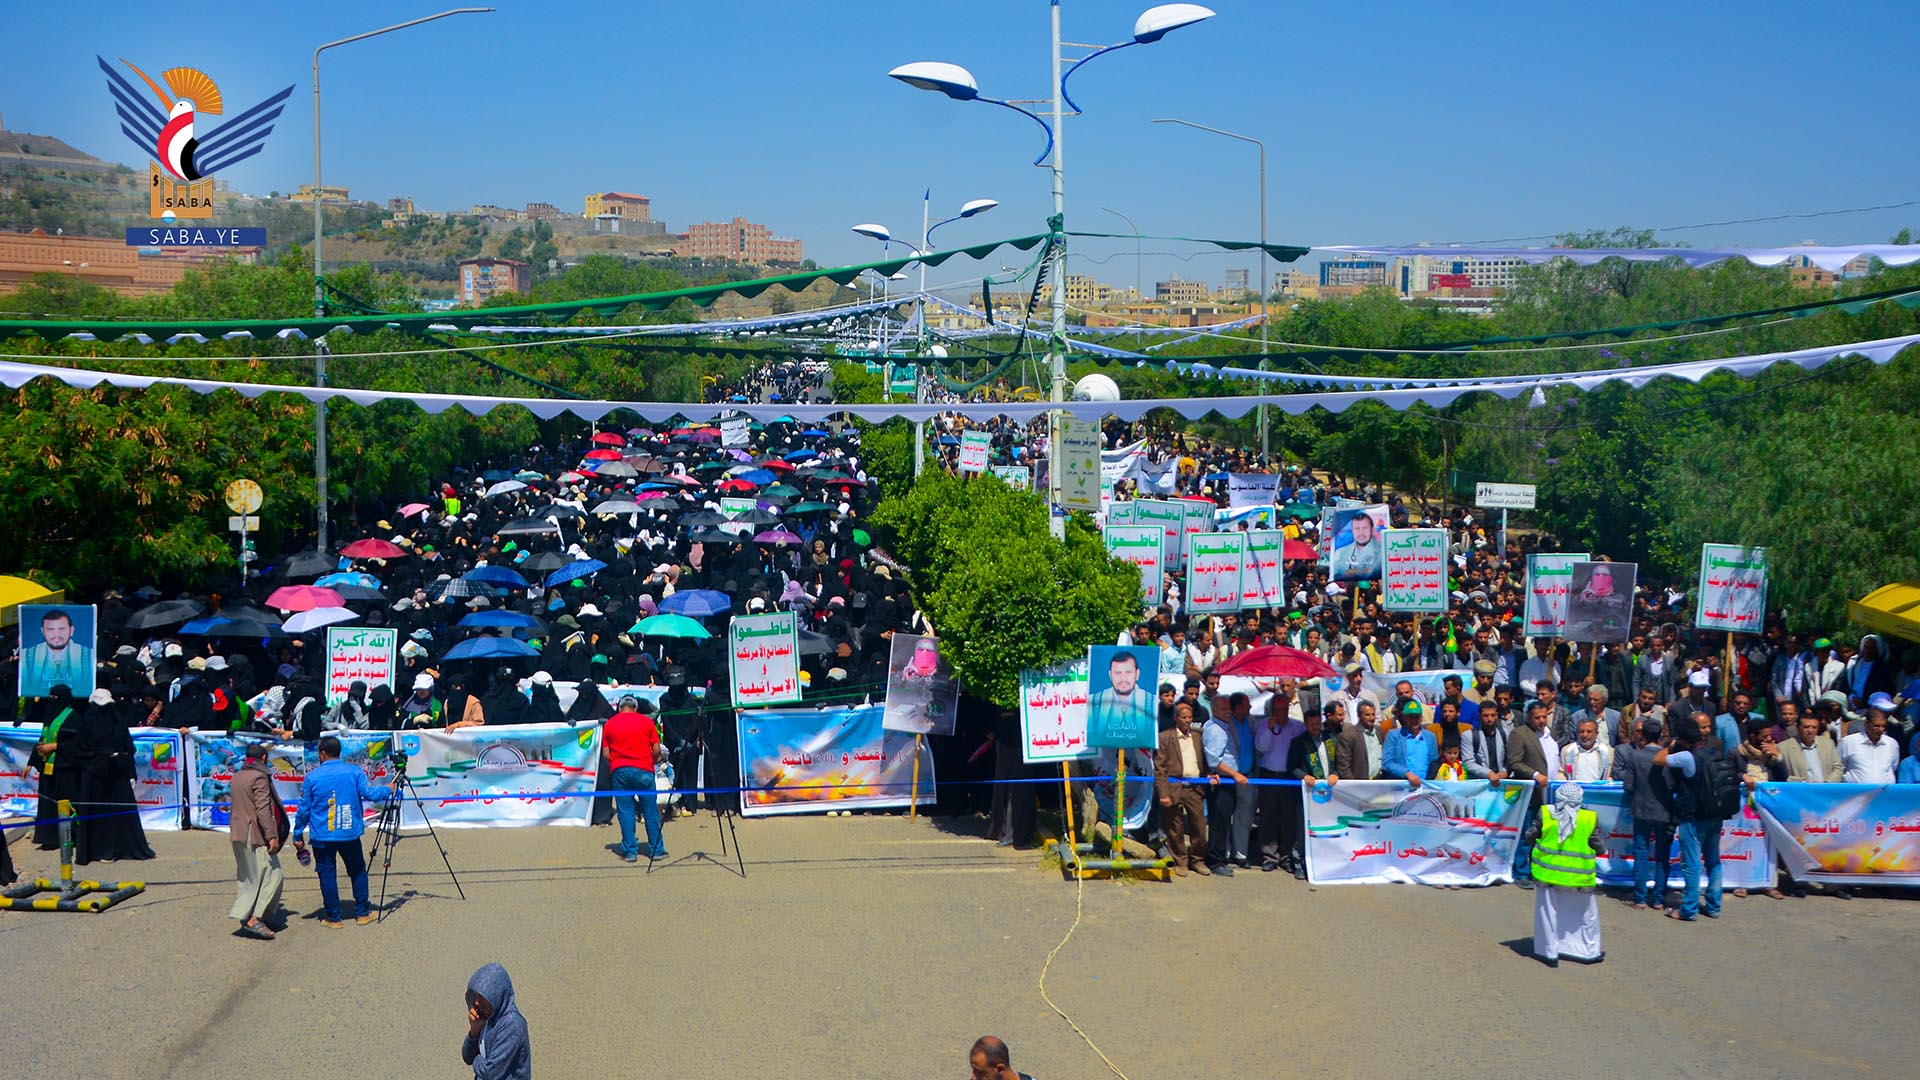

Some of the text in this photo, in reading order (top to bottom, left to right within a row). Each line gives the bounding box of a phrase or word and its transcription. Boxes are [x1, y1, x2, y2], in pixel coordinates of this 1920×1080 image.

[1137, 505, 1181, 521] قاطعوا
[1109, 533, 1159, 550] قاطعوا
[1194, 540, 1241, 558] قاطعوا
[1388, 535, 1441, 553] الله أكبر
[733, 619, 792, 642] قاطعوا
[332, 630, 391, 652] الله أكبر
[364, 653, 390, 665] الموت
[736, 643, 793, 661] البضائع الأمريكية
[363, 668, 390, 680] الموت
[762, 663, 767, 676] و
[738, 677, 796, 697] الإسرائيلية
[1062, 692, 1088, 709] لبضائع
[1057, 712, 1063, 726] و
[1803, 818, 1840, 836] ثانية
[1876, 820, 1884, 837] و
[1349, 840, 1393, 862] النصر
[1397, 843, 1429, 859] حتى
